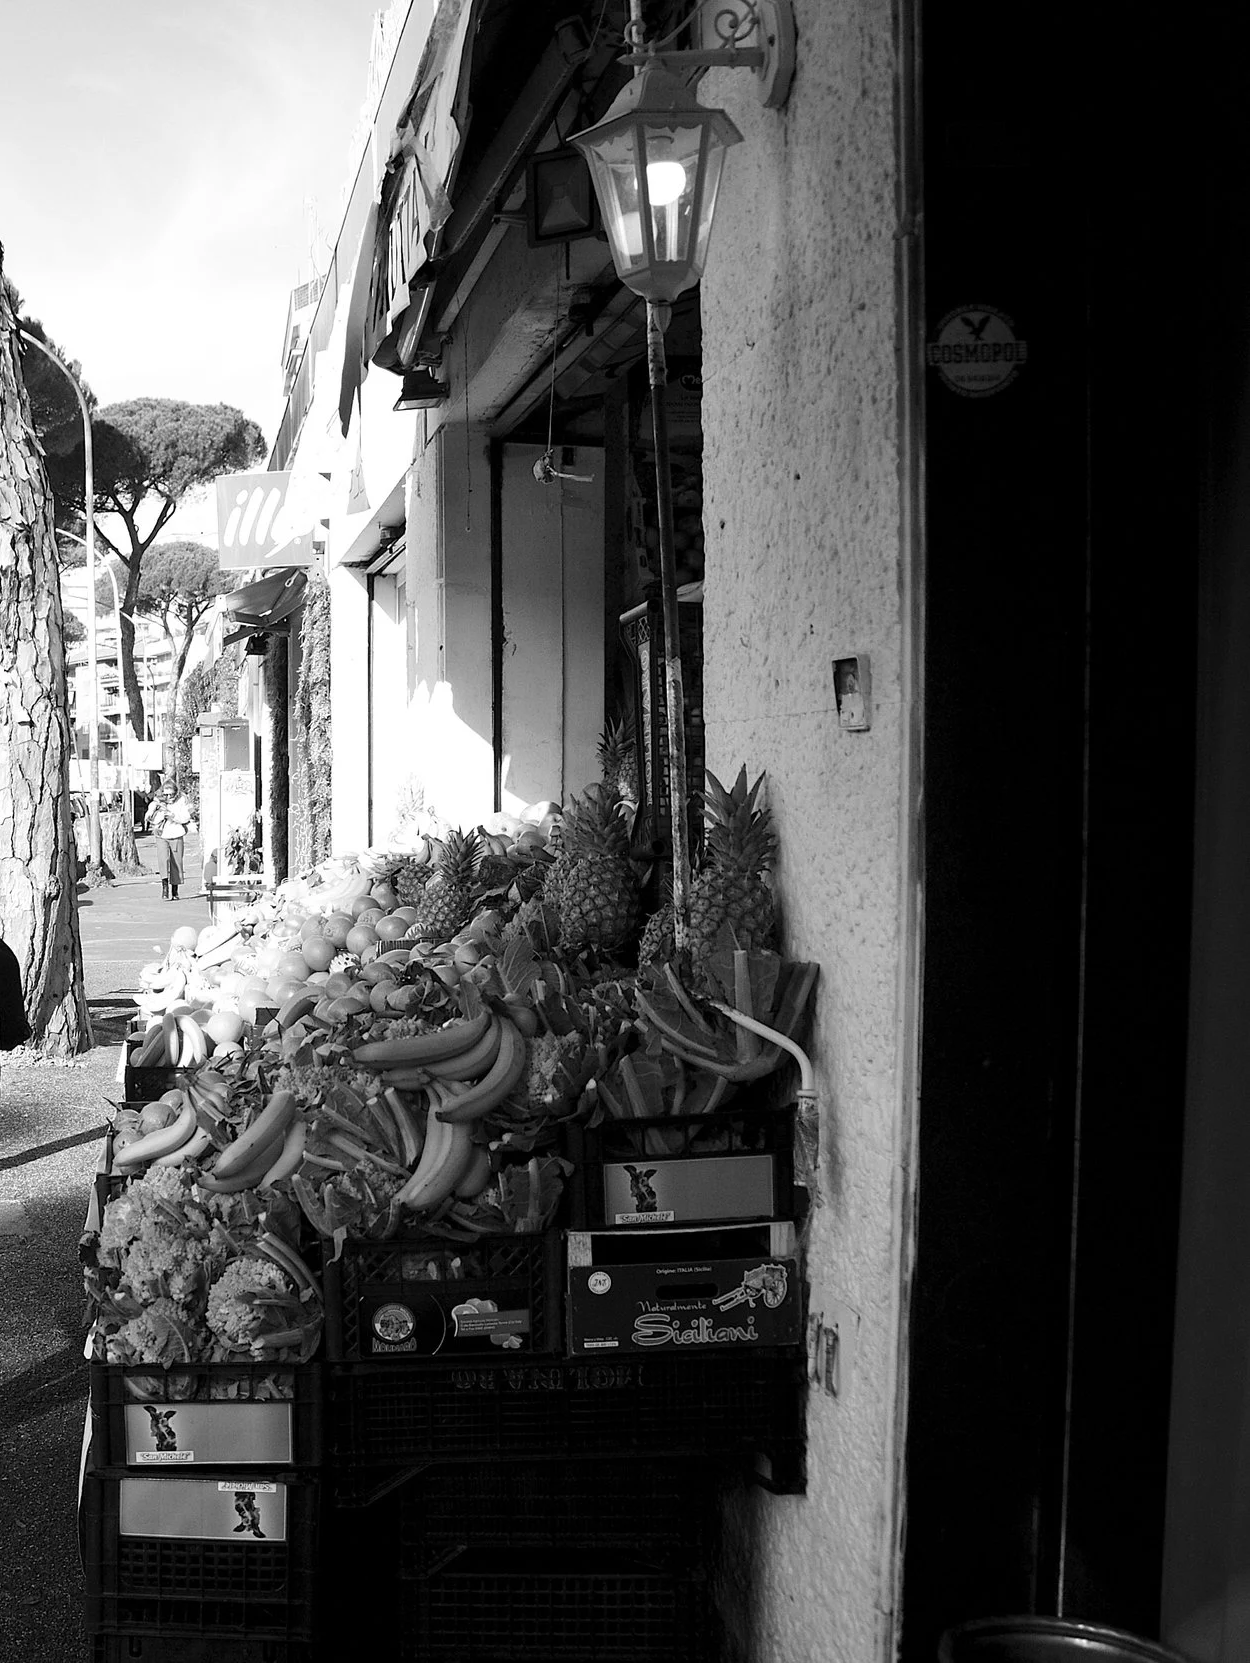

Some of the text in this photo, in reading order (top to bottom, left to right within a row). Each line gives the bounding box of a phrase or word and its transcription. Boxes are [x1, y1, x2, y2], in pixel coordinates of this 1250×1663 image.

[930, 342, 1024, 364] COSMOPOL
[676, 1266, 693, 1274] ITALIA
[636, 1300, 708, 1313] Naturalmente
[631, 1312, 759, 1347] Siciliani
